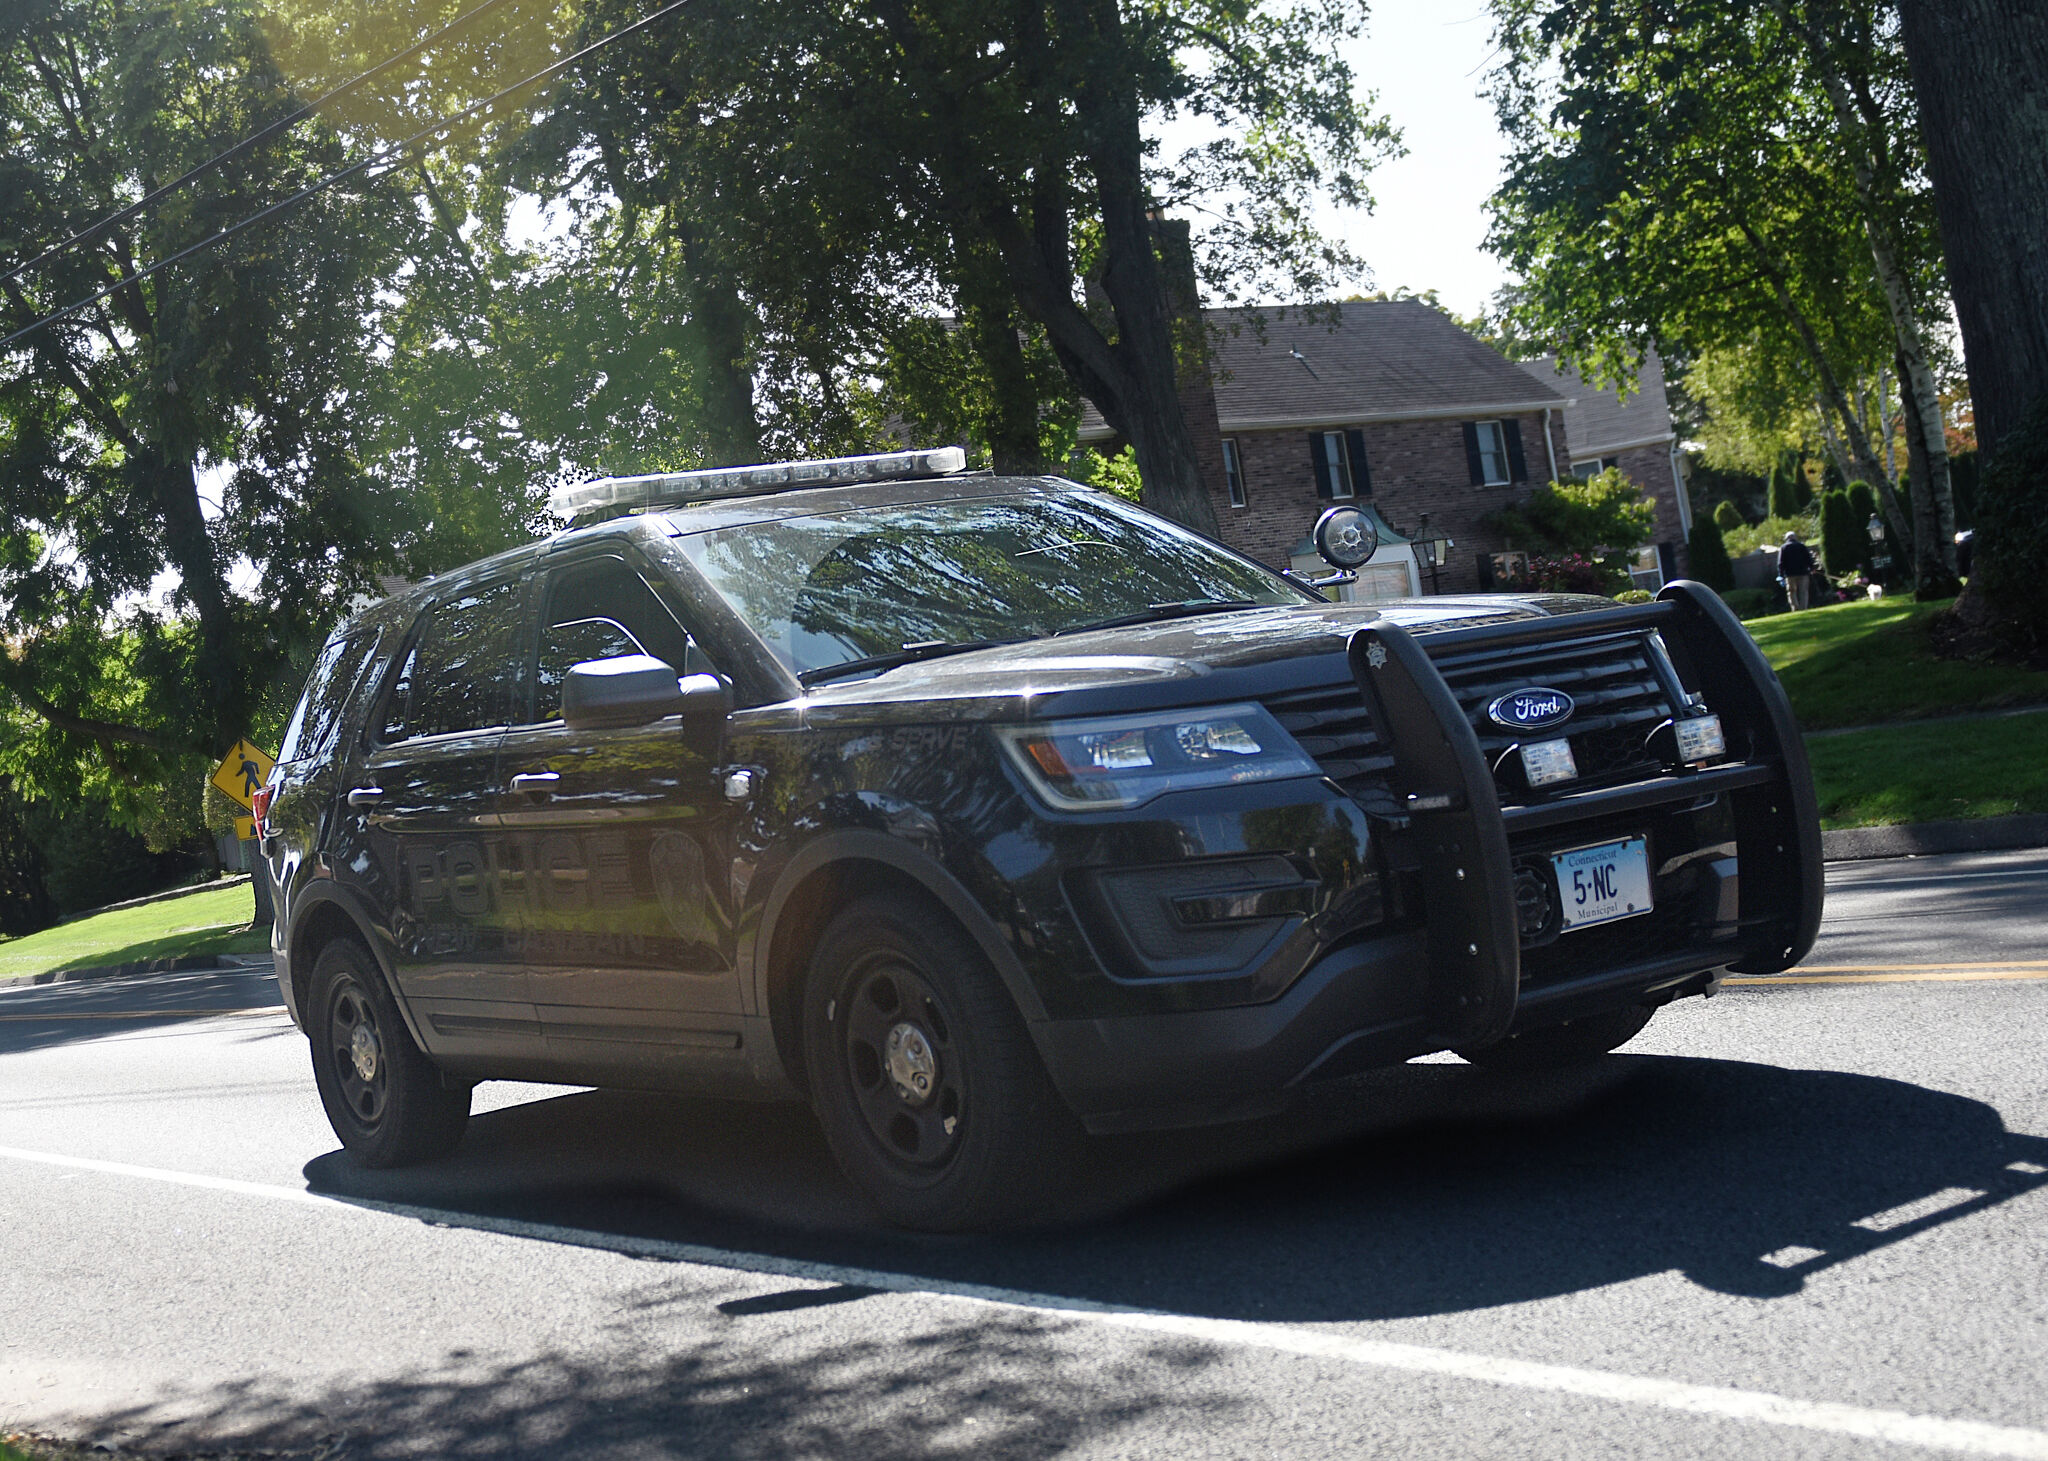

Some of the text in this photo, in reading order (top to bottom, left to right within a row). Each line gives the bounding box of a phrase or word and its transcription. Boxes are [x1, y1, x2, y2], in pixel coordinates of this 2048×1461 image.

[1515, 696, 1561, 720] Ford
[889, 727, 968, 751] SERVE
[1568, 850, 1617, 868] Connecticut
[406, 832, 632, 920] POLICE
[1577, 902, 1618, 919] Municipal
